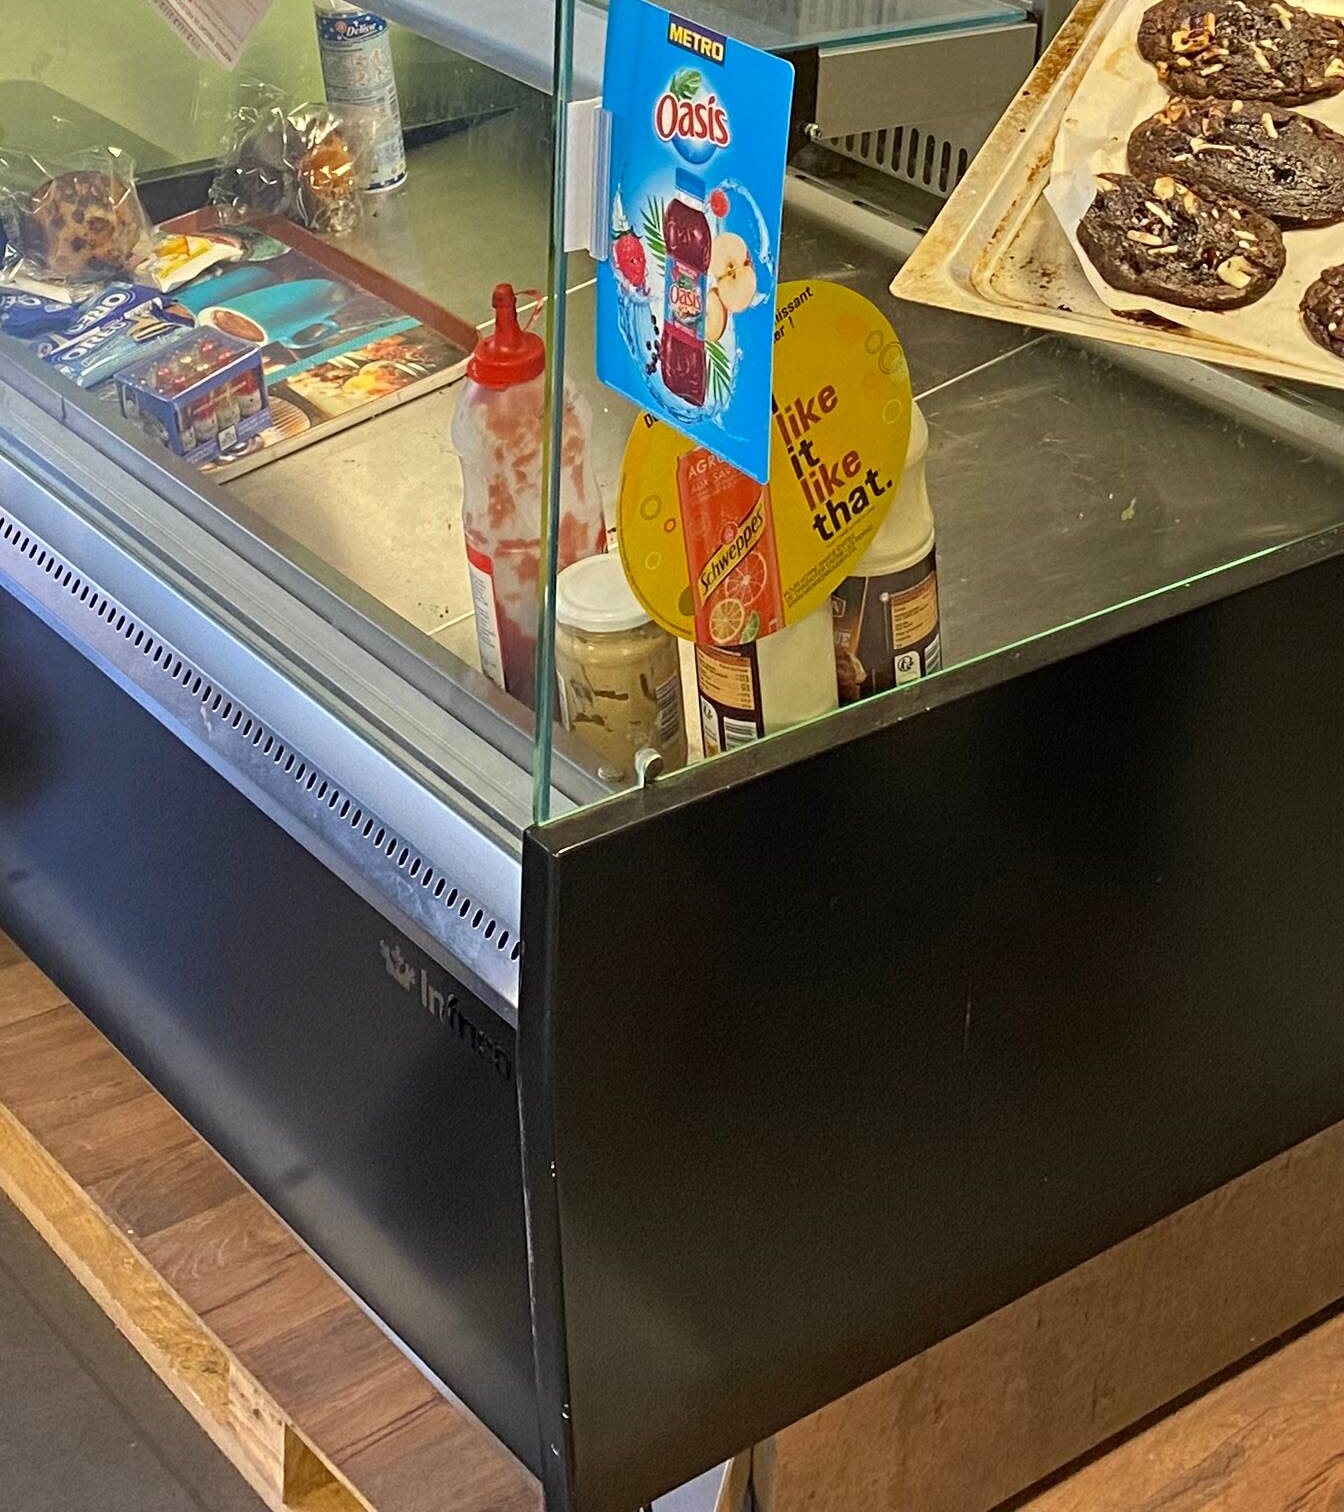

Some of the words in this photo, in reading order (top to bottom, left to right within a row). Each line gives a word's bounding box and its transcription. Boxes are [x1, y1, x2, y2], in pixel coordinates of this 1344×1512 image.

[669, 23, 725, 62] METRO
[656, 94, 730, 146] Oasis
[775, 384, 838, 446] like
[788, 438, 820, 480] it
[799, 450, 862, 511] like
[813, 468, 894, 541] that.
[700, 507, 764, 595] Schweppes
